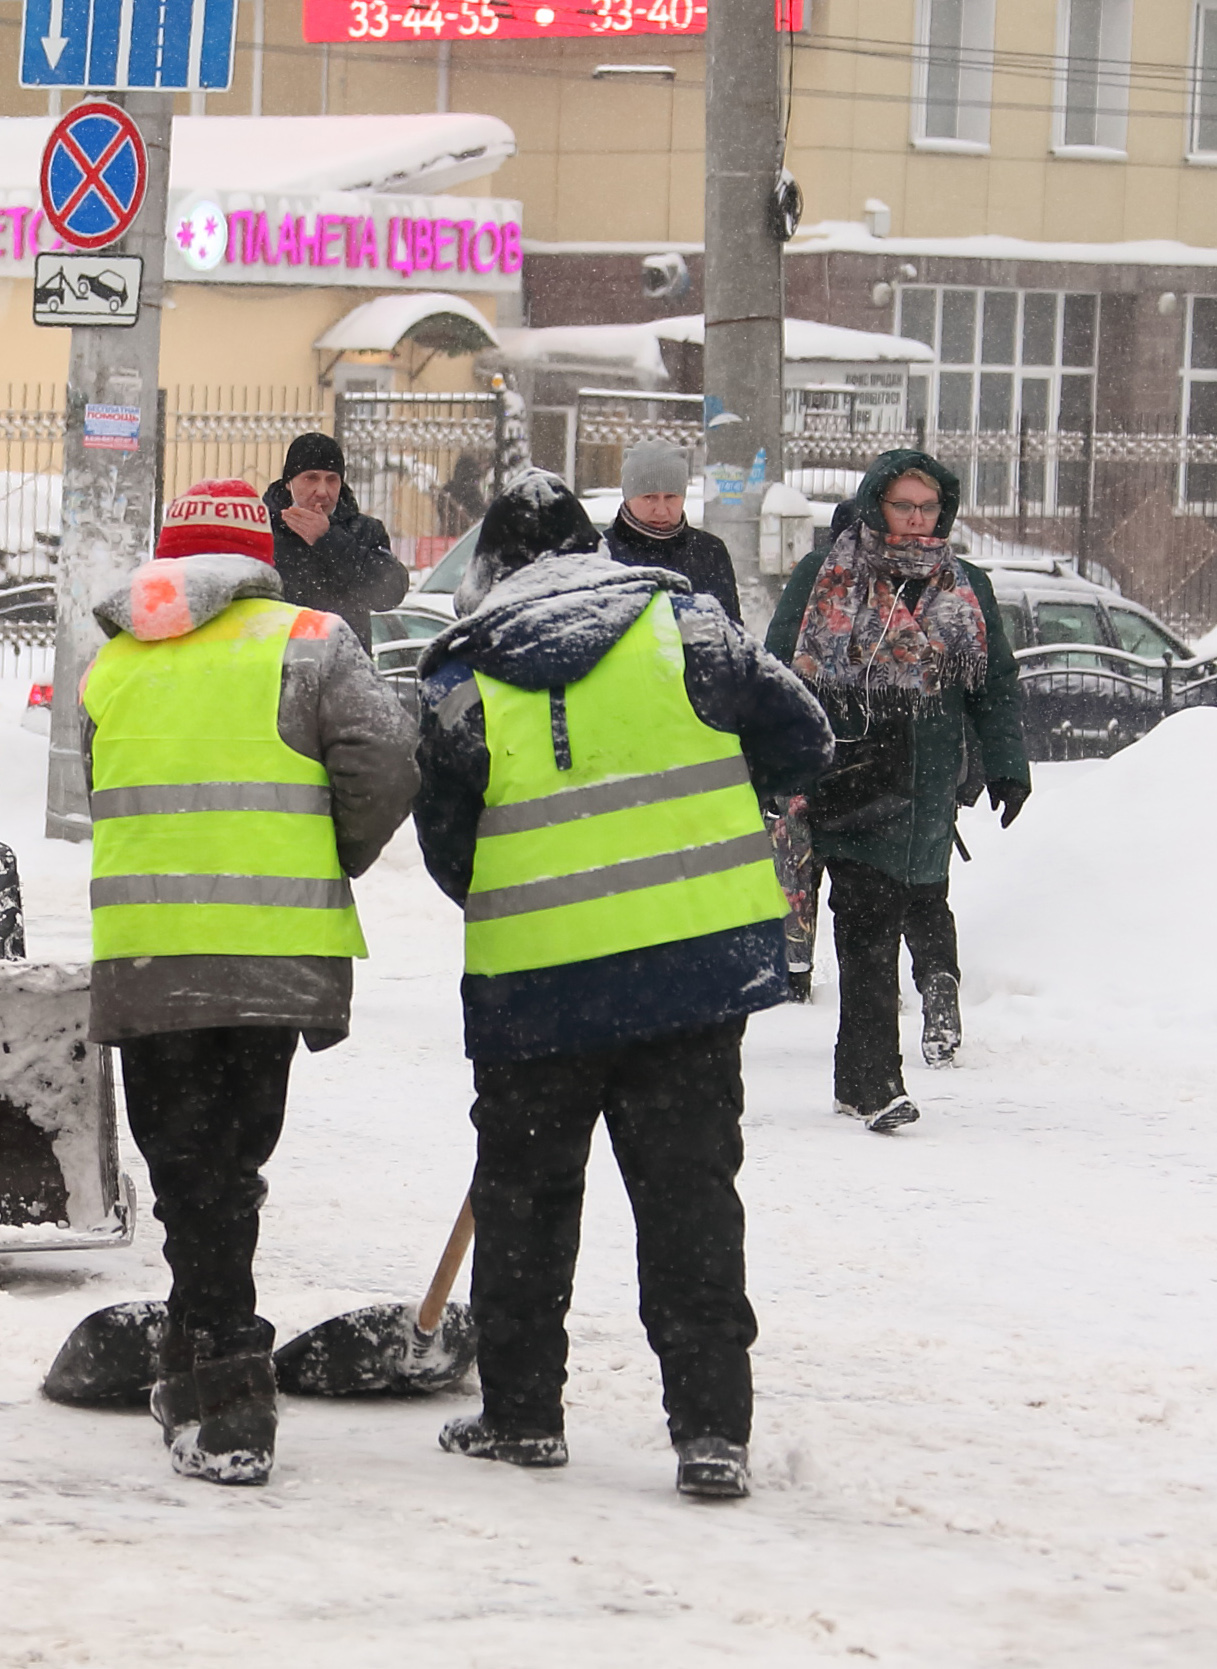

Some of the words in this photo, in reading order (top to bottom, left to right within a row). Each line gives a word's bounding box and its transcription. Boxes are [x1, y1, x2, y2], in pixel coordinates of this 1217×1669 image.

[347, 0, 499, 37] 33-44-55
[225, 209, 379, 268] ПЛАНЕТА
[387, 216, 524, 278] ЦВЕТОВ
[87, 411, 139, 422] ПОМОЩЬ
